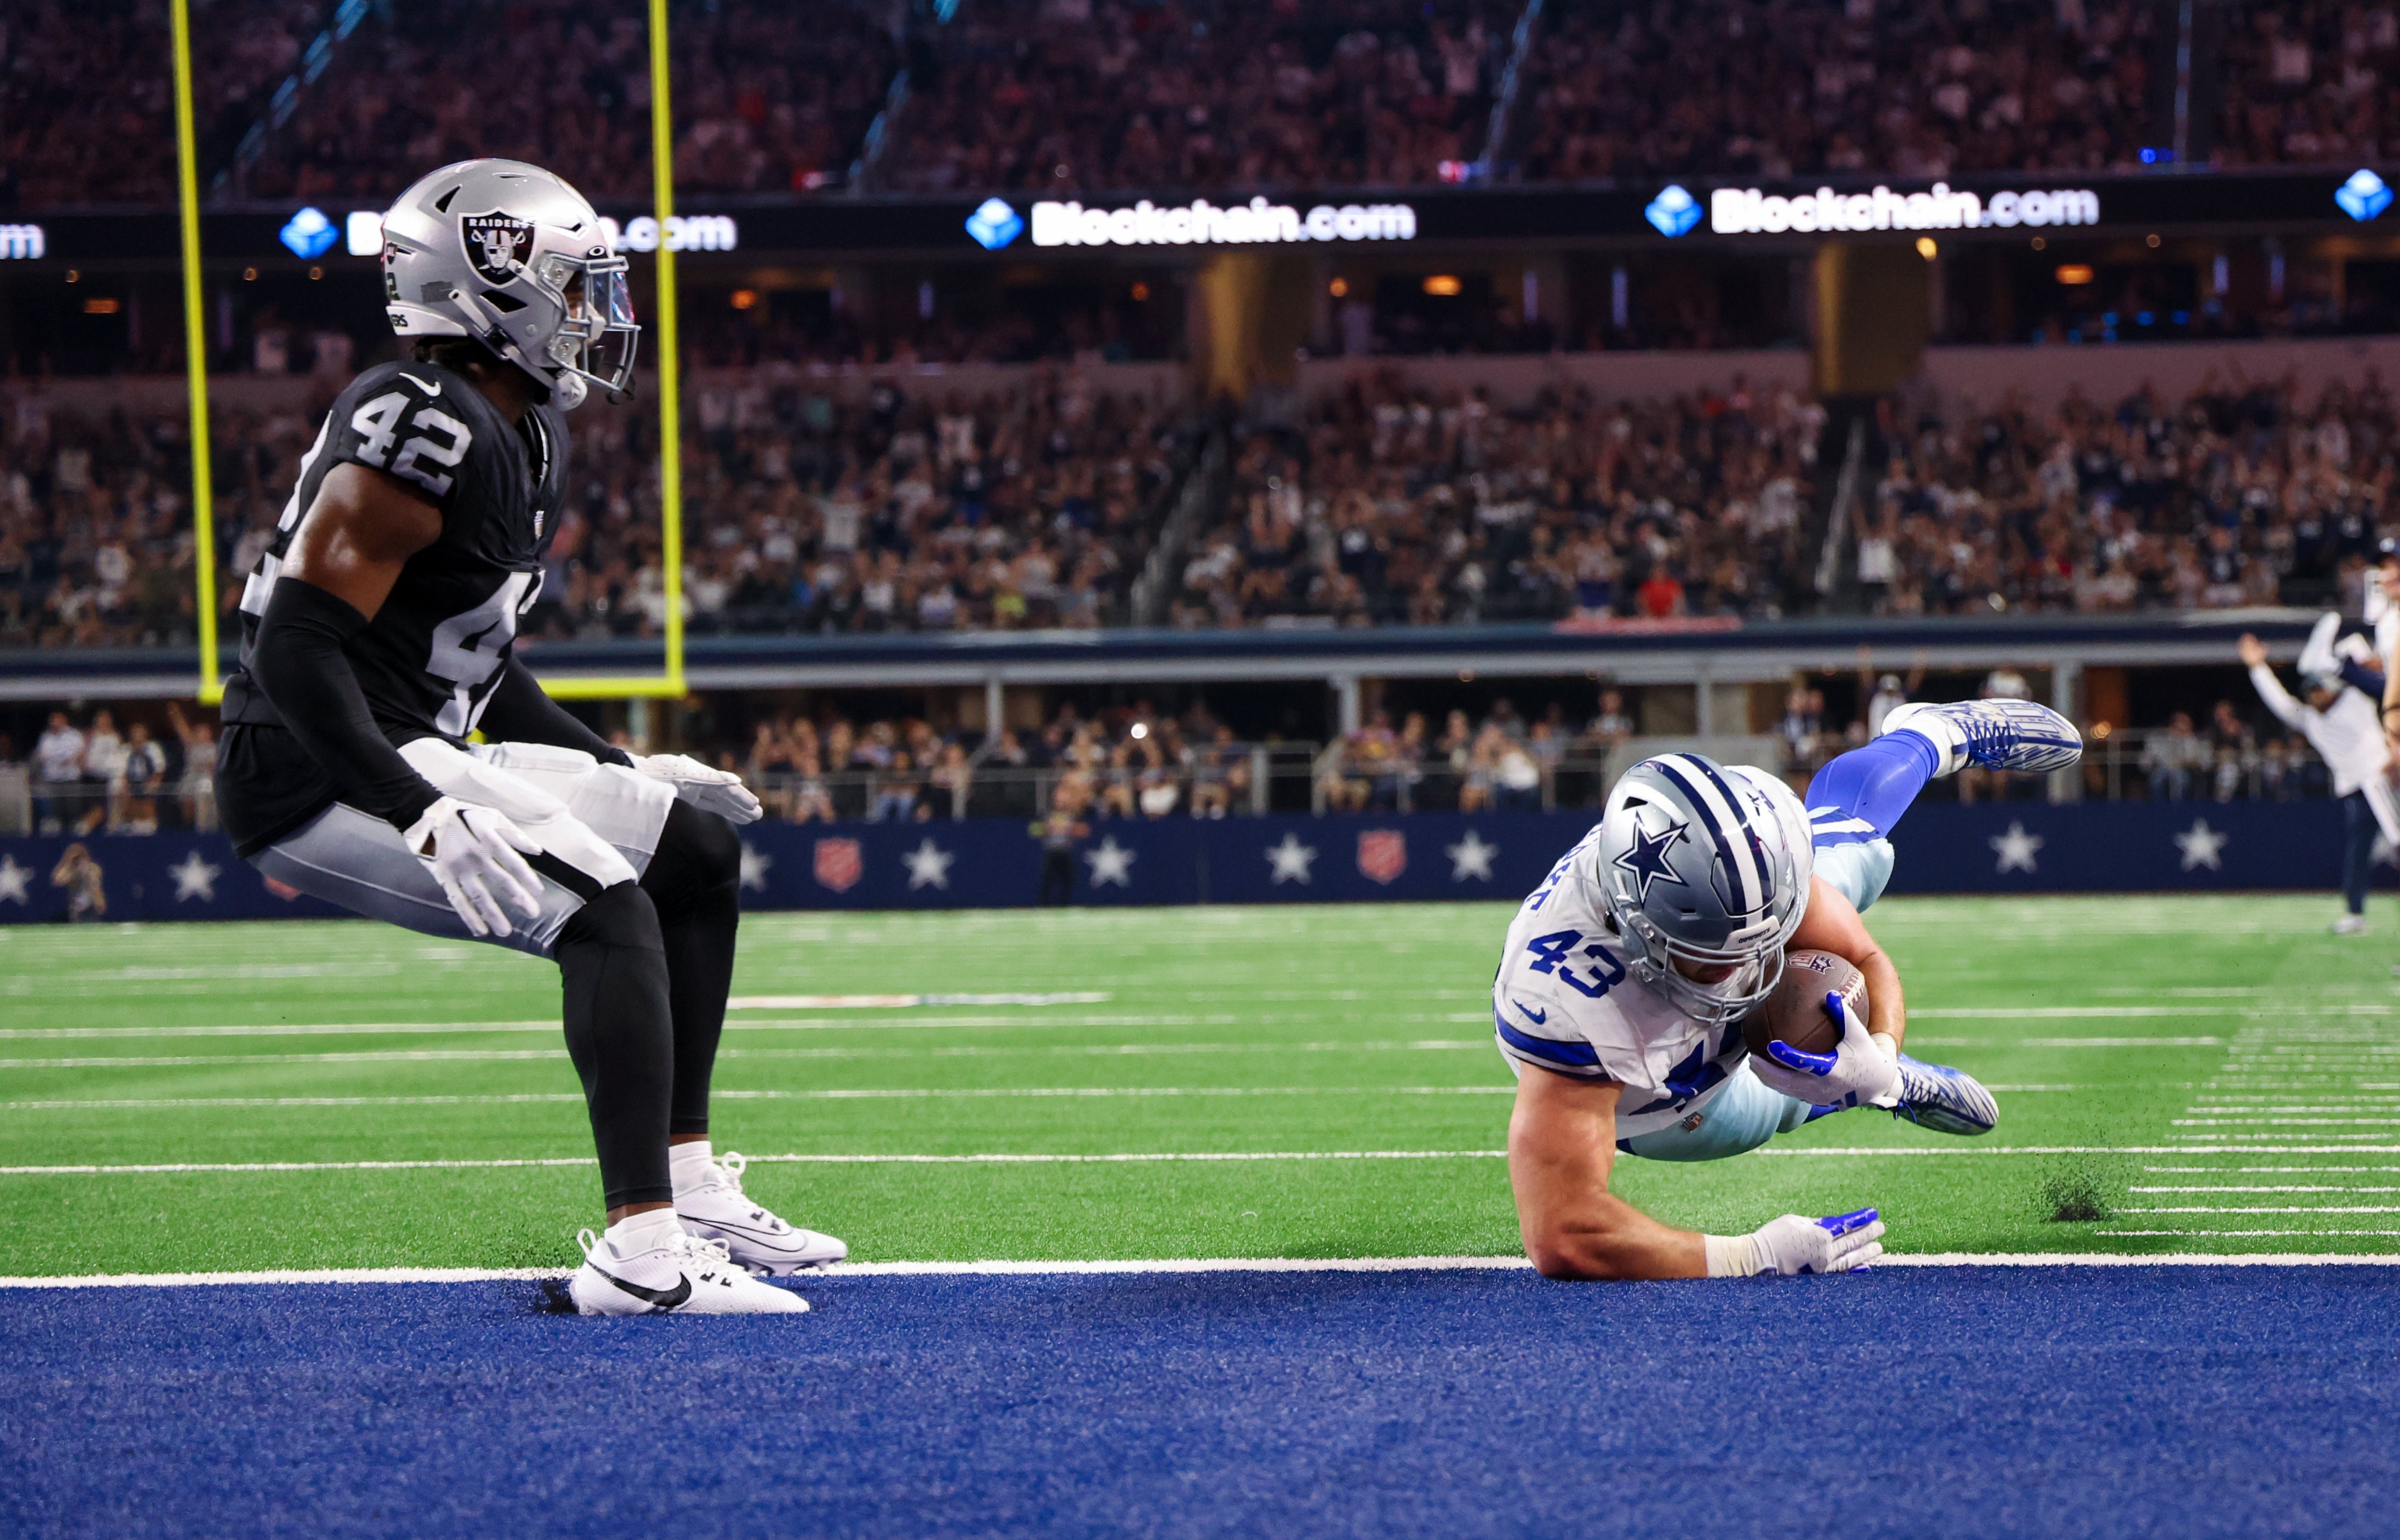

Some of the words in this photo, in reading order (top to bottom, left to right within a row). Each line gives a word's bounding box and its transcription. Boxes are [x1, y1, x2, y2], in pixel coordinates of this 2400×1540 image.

[1032, 197, 1416, 247] Blockchain.com
[1711, 183, 2099, 234] Blockchain.com
[351, 391, 473, 496] 42
[426, 569, 546, 736] 4
[1527, 929, 1626, 998] 43
